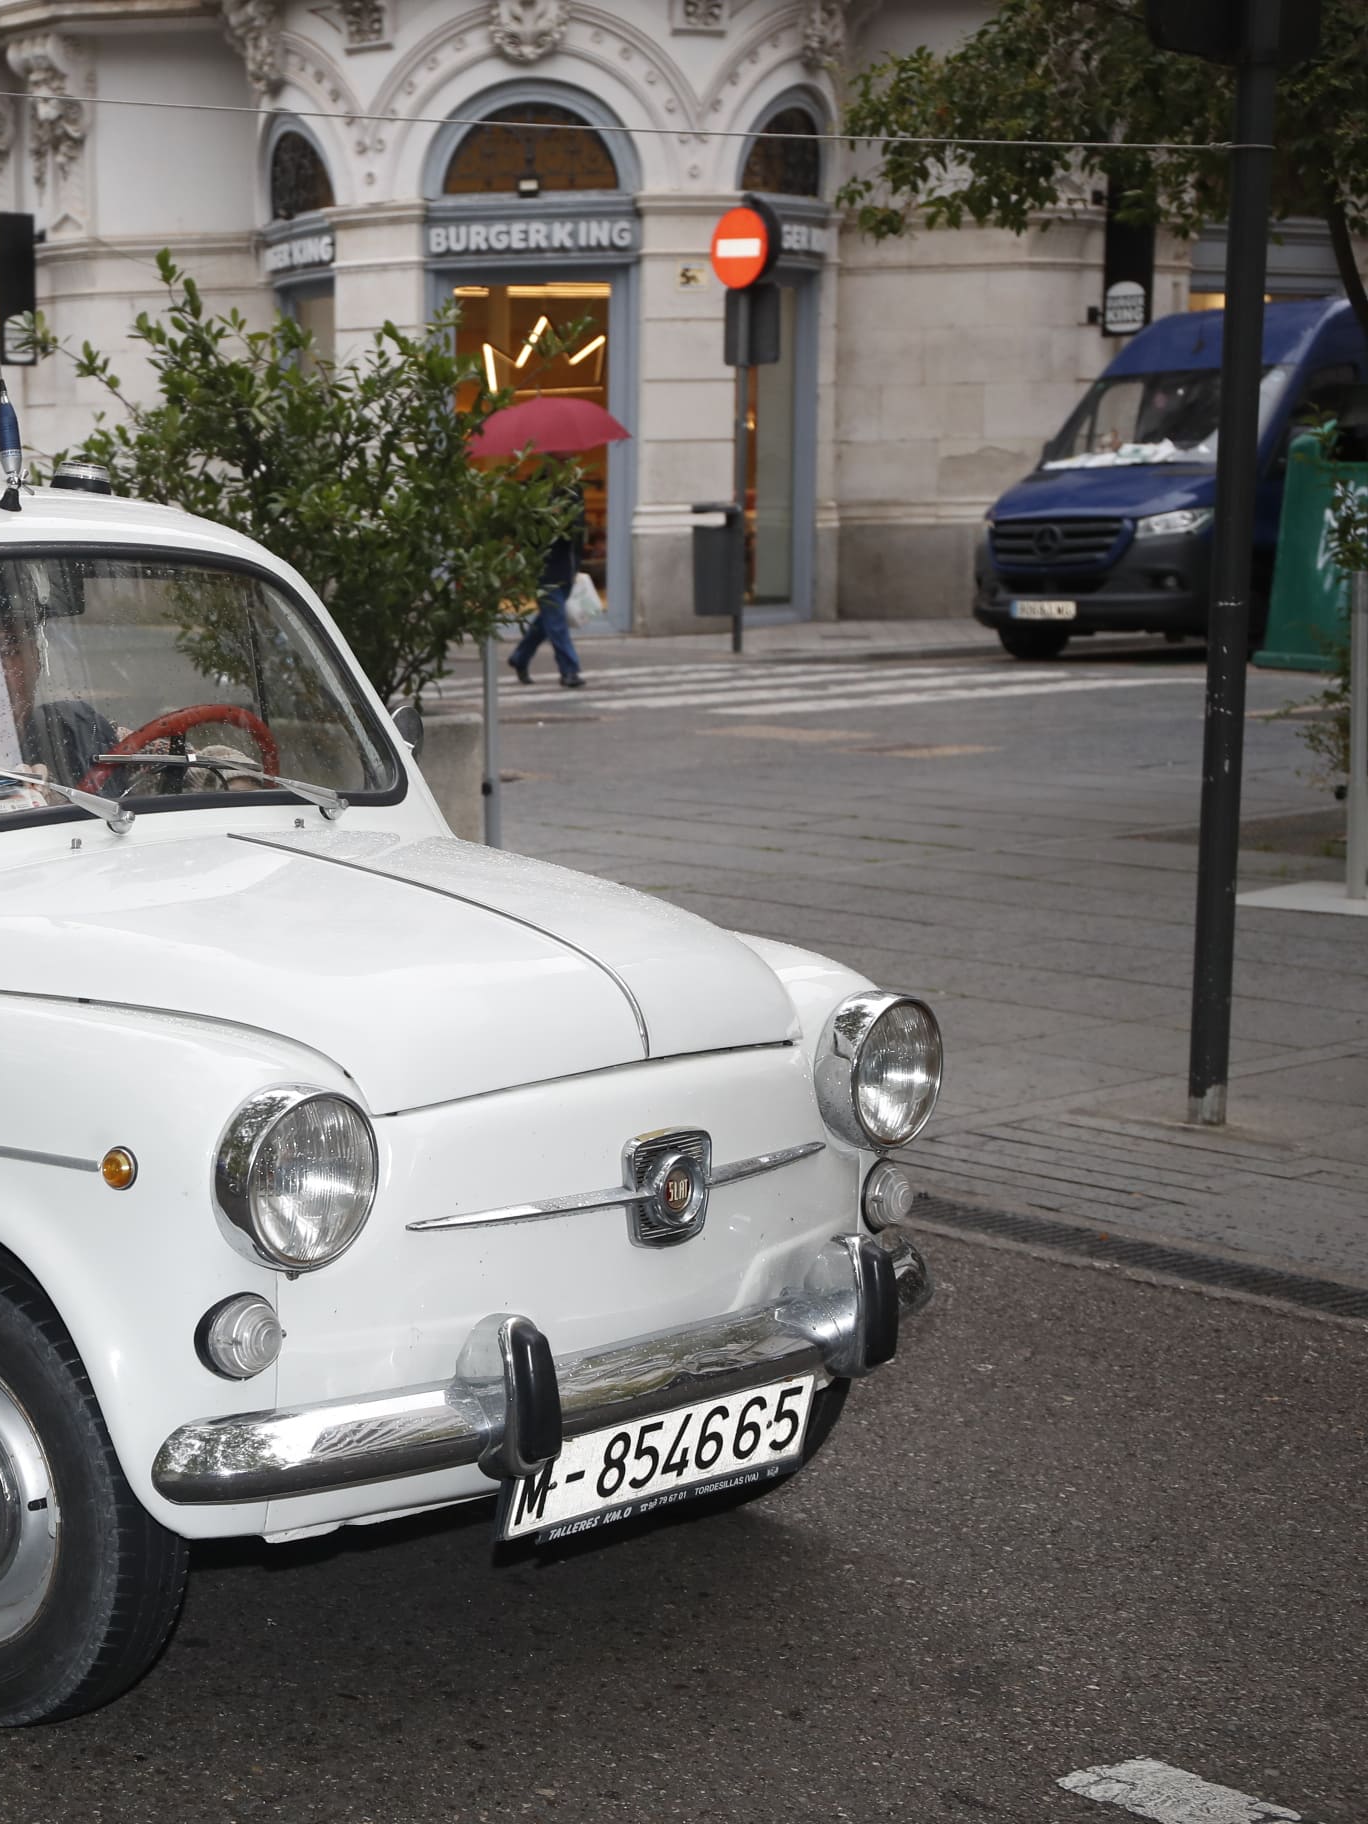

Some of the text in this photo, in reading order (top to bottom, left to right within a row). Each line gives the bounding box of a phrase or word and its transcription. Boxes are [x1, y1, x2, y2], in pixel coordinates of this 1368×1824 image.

[292, 235, 333, 265] KING
[429, 220, 632, 253] BURGER KING
[548, 1515, 601, 1541] TALLERES
[694, 1476, 745, 1497] TORDESILLAS
[744, 1472, 759, 1486] (VA)
